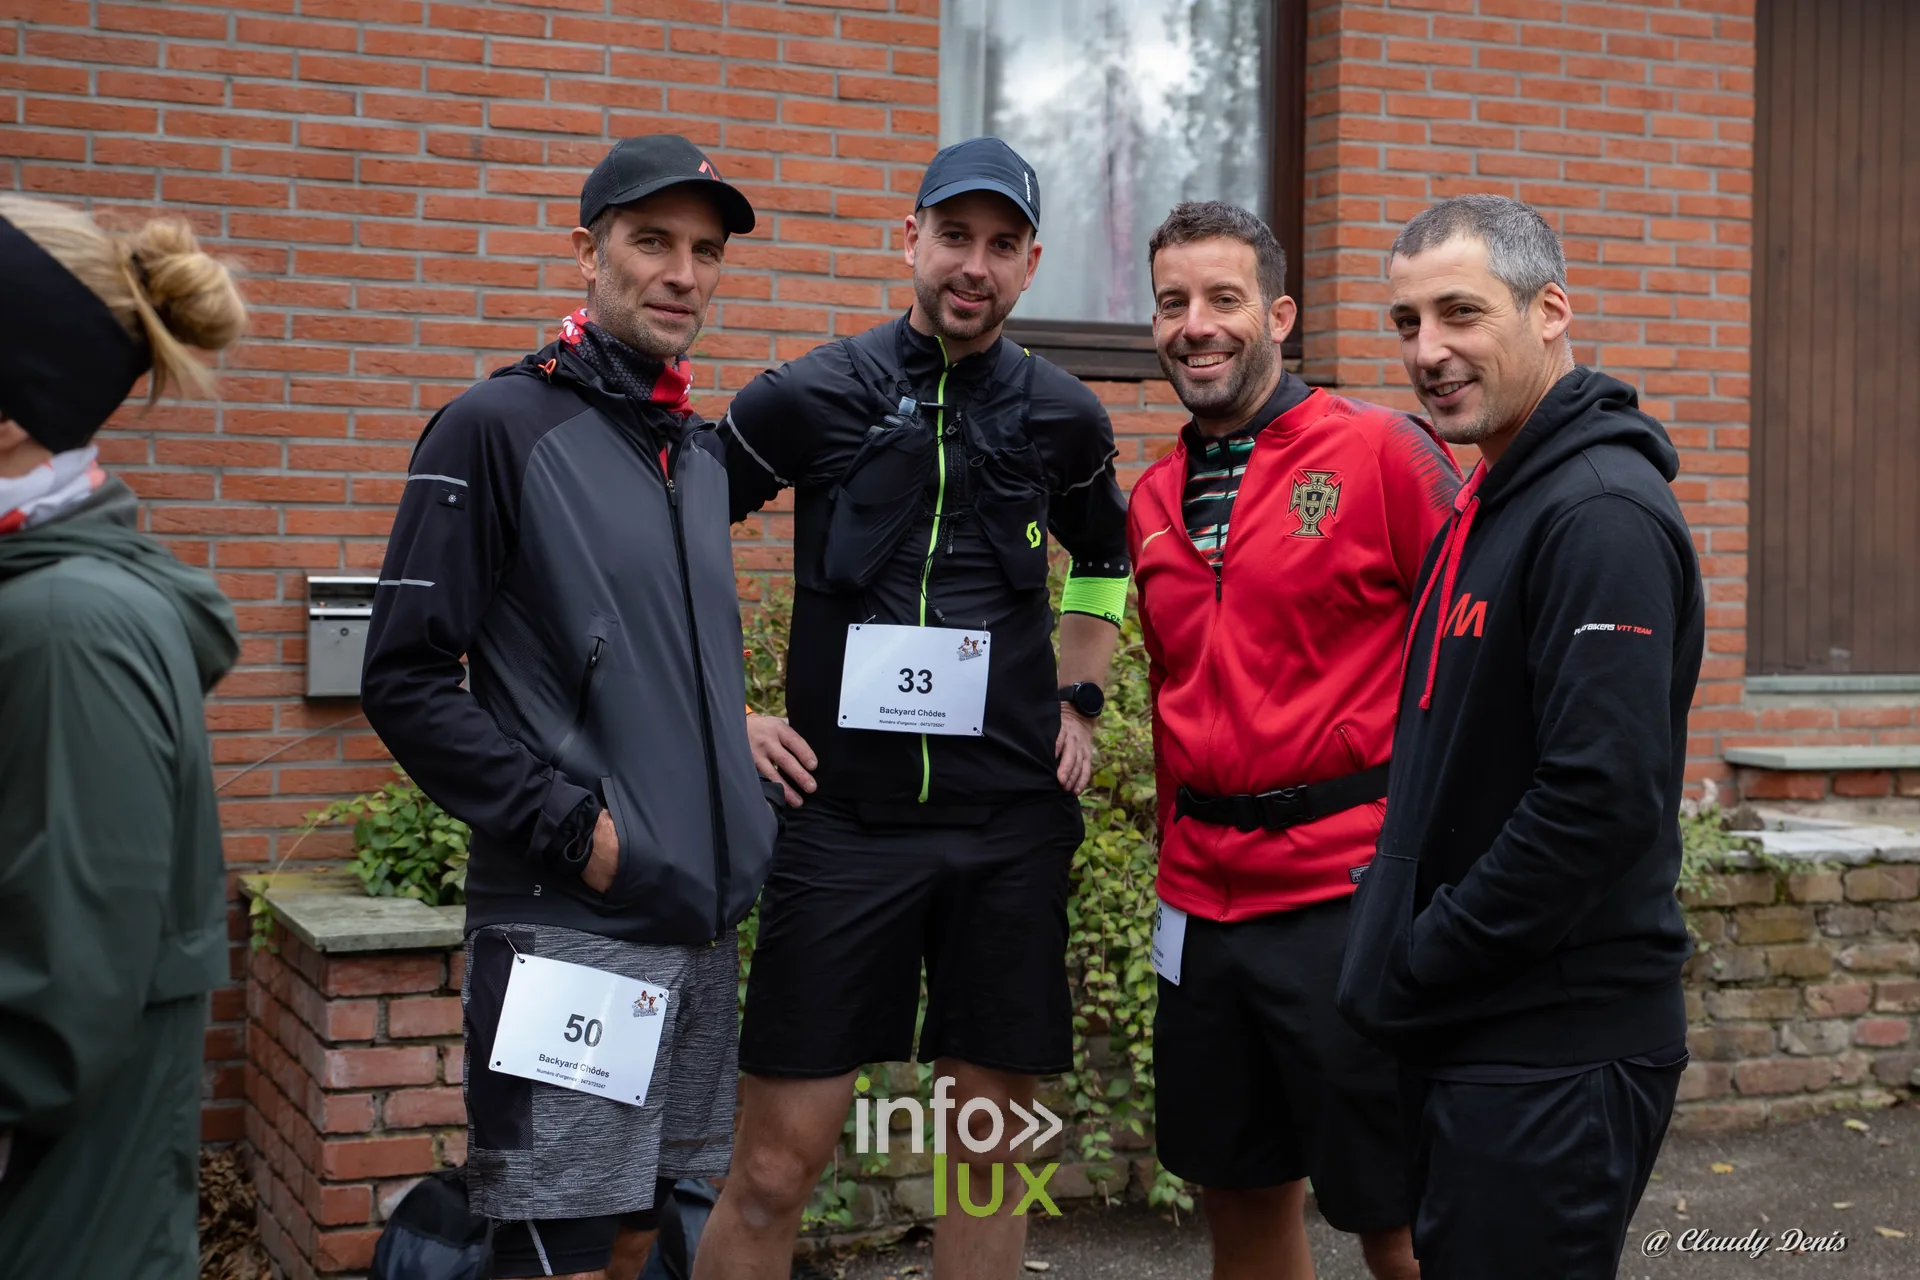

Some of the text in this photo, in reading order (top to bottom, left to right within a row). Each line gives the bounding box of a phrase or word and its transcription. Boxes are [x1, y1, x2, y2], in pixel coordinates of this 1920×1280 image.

[1633, 626, 1652, 635] TEAM
[898, 668, 932, 694] 33
[879, 706, 946, 718] Backyard Chôdes
[564, 1013, 603, 1047] 50
[538, 1053, 610, 1078] Backyard Chôdes
